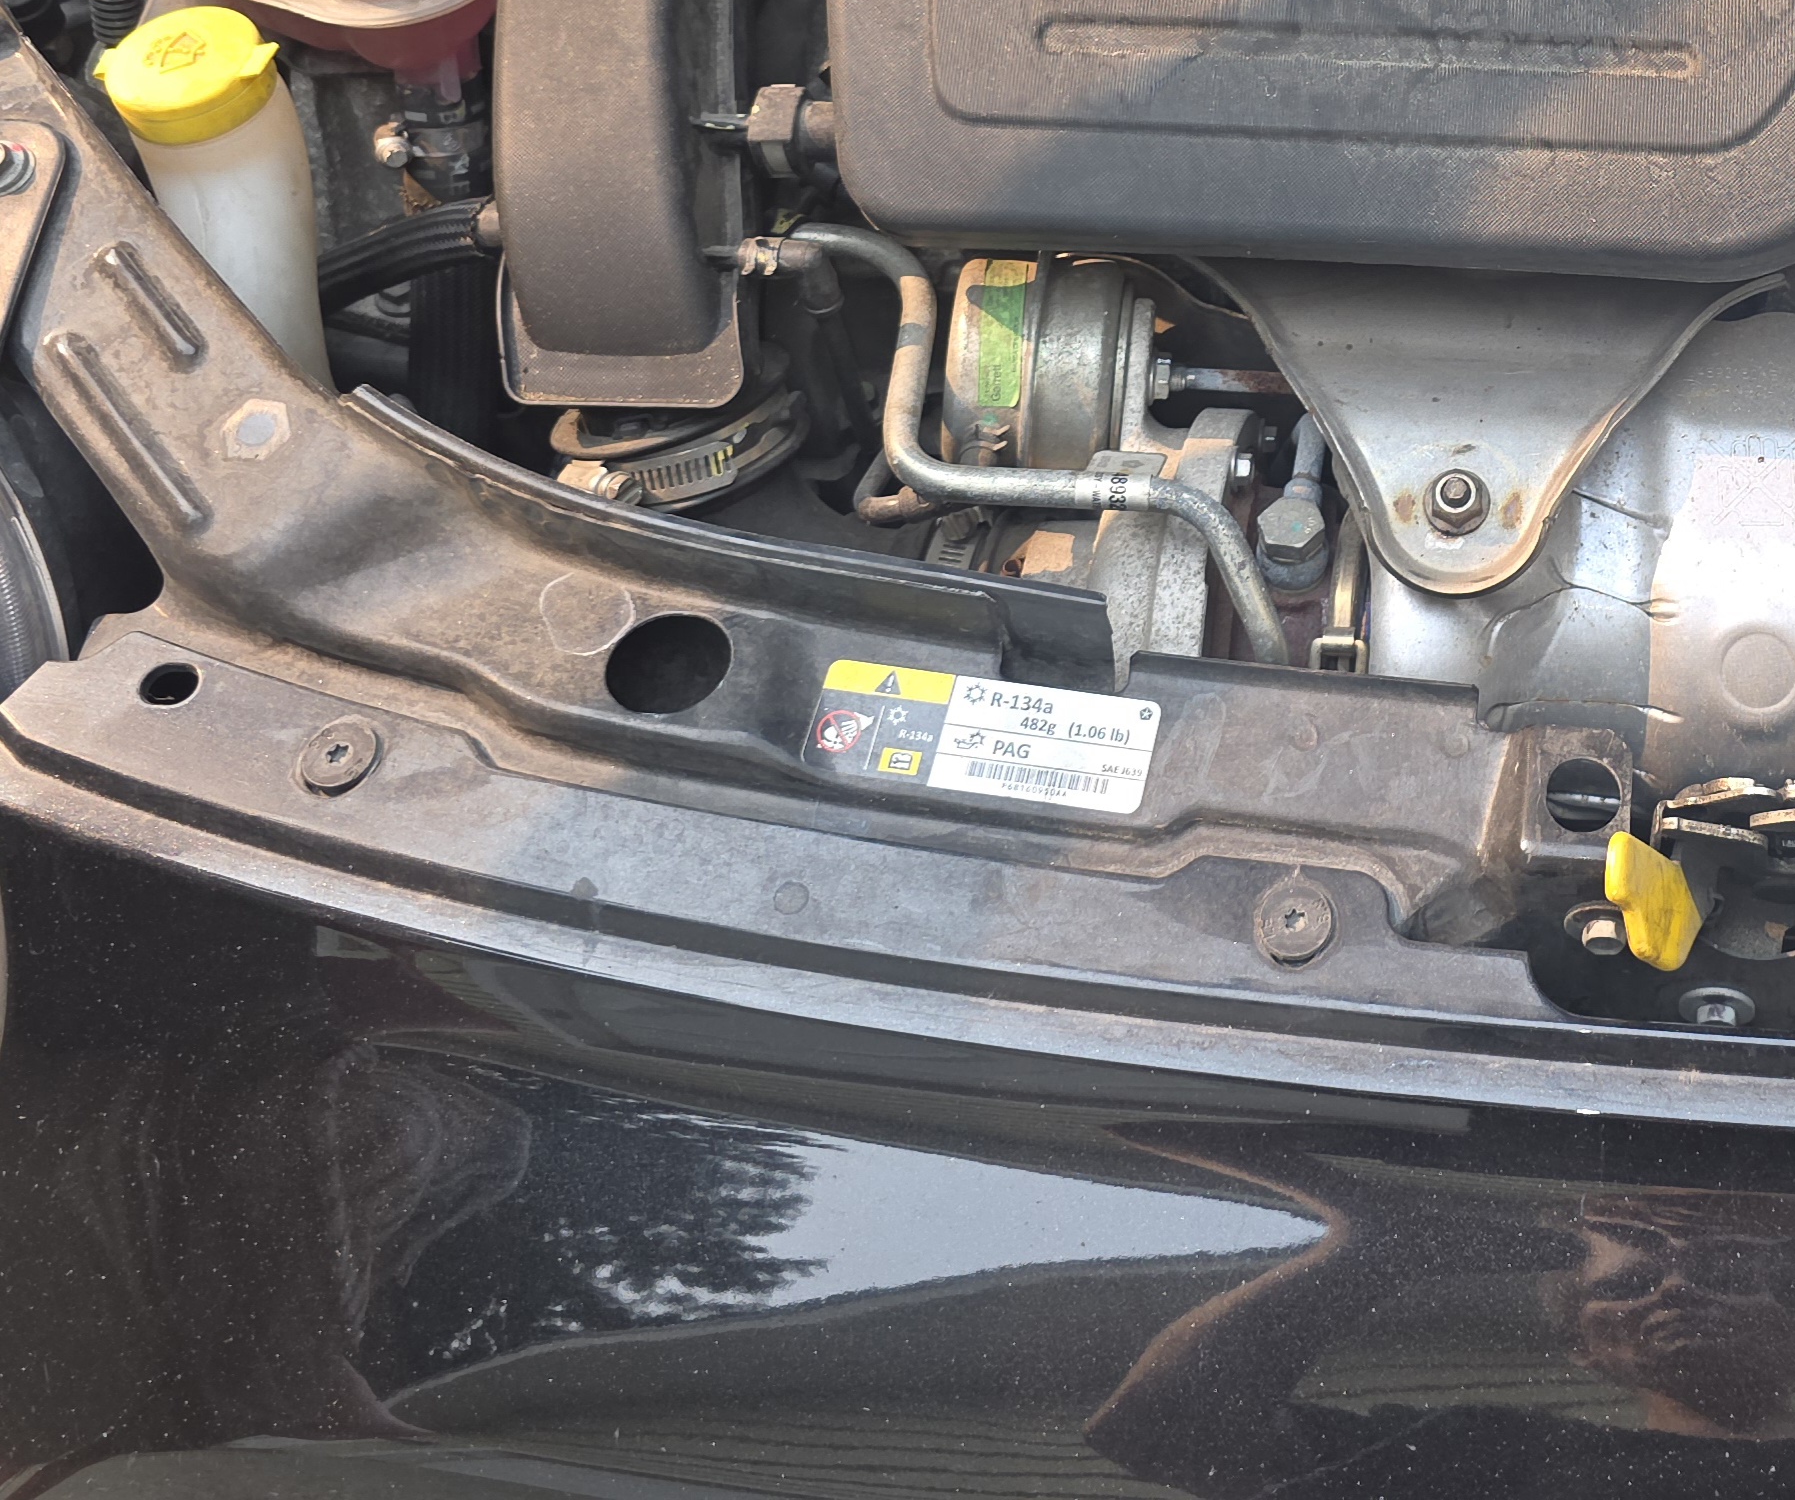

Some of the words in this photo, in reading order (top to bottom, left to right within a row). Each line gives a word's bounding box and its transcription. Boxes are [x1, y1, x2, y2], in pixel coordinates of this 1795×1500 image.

[990, 691, 1054, 715] R-134a
[898, 729, 934, 743] R-134a
[1020, 716, 1057, 736] 482g
[1068, 721, 1106, 740] (1.06
[1110, 725, 1130, 746] lb)
[992, 739, 1032, 760] PAG
[1101, 763, 1119, 775] SAE
[1120, 766, 1143, 778] J639
